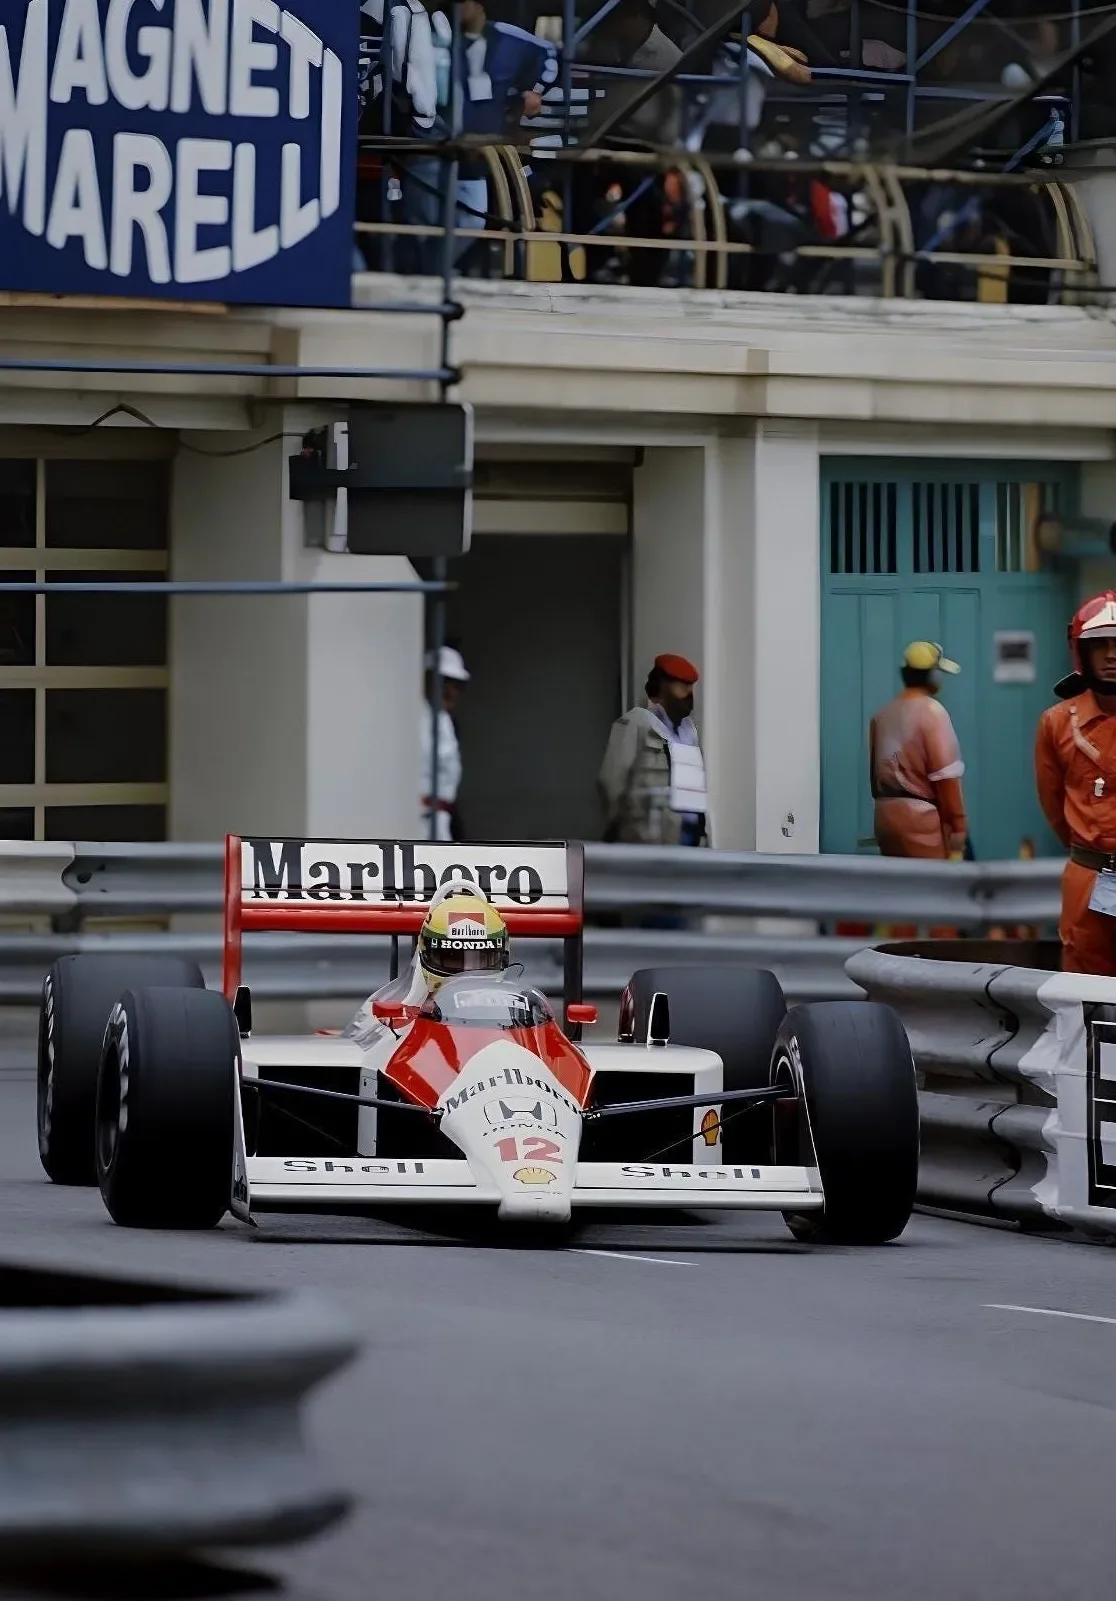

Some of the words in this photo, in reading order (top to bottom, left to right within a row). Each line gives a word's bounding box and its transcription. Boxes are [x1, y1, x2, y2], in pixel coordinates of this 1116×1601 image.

[0, 0, 342, 190] MAGNETI
[0, 100, 342, 284] MARELLI
[441, 939, 496, 950] HONDA
[493, 1136, 564, 1164] 12
[283, 1160, 425, 1174] Shell
[620, 1165, 761, 1179] Shell
